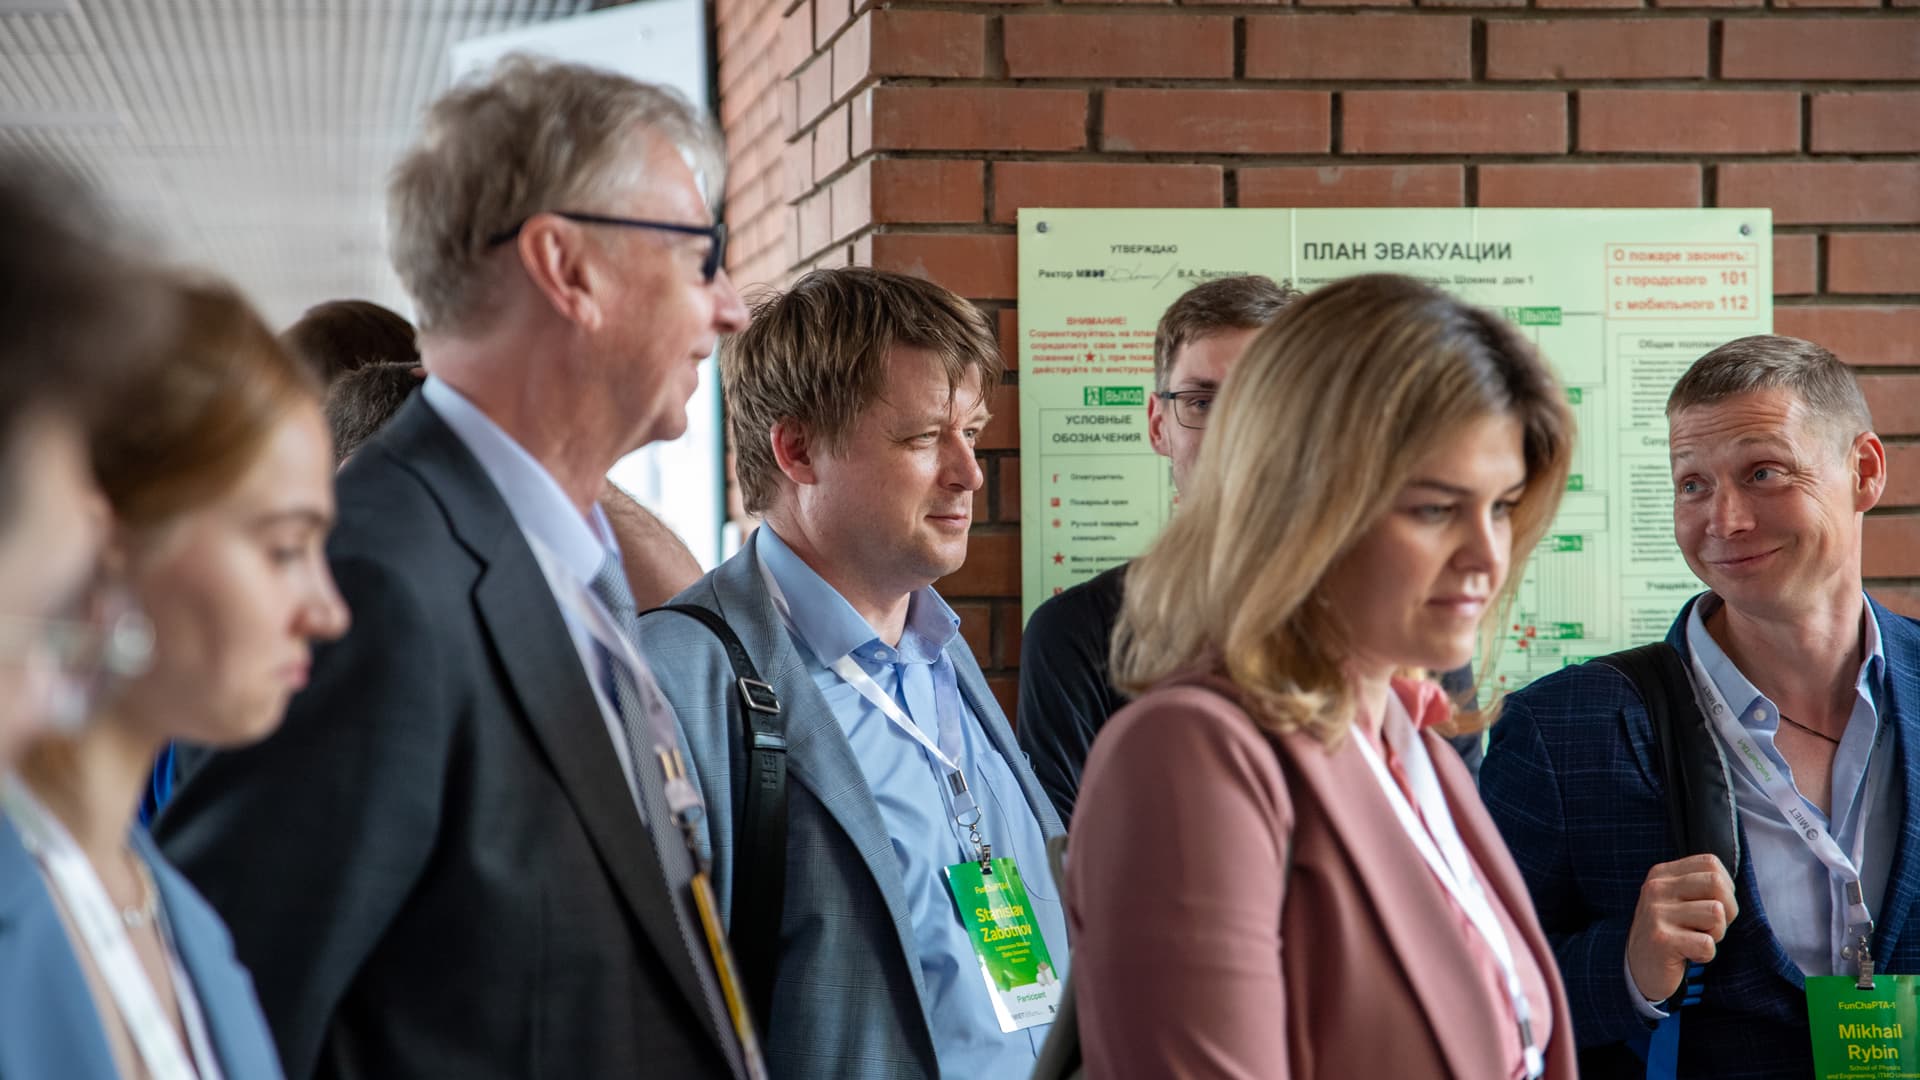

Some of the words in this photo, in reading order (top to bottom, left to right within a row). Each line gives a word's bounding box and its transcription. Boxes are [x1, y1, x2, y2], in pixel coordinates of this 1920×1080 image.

[1110, 244, 1178, 254] УТВЕРЖДАЮ
[1303, 242, 1367, 260] ПЛАН
[1374, 242, 1513, 263] ЭВАКУАЦИИ
[1613, 249, 1625, 261] О
[1629, 251, 1682, 263] пожаре
[1626, 275, 1708, 288] городского
[1720, 271, 1748, 285] 101
[1627, 297, 1715, 311] мобильного
[1720, 296, 1749, 310] 112
[1104, 389, 1142, 402] ВЫХОД
[1066, 415, 1132, 425] УСЛОВНЫЕ
[1052, 433, 1142, 443] ОБОЗНАЧЕНИЯ
[1788, 807, 1811, 830] MIET
[975, 904, 1025, 923] Stanislav
[980, 924, 1032, 942] Zabotnov
[1838, 1024, 1903, 1039] Mikhail
[1847, 1044, 1898, 1063] Rybin
